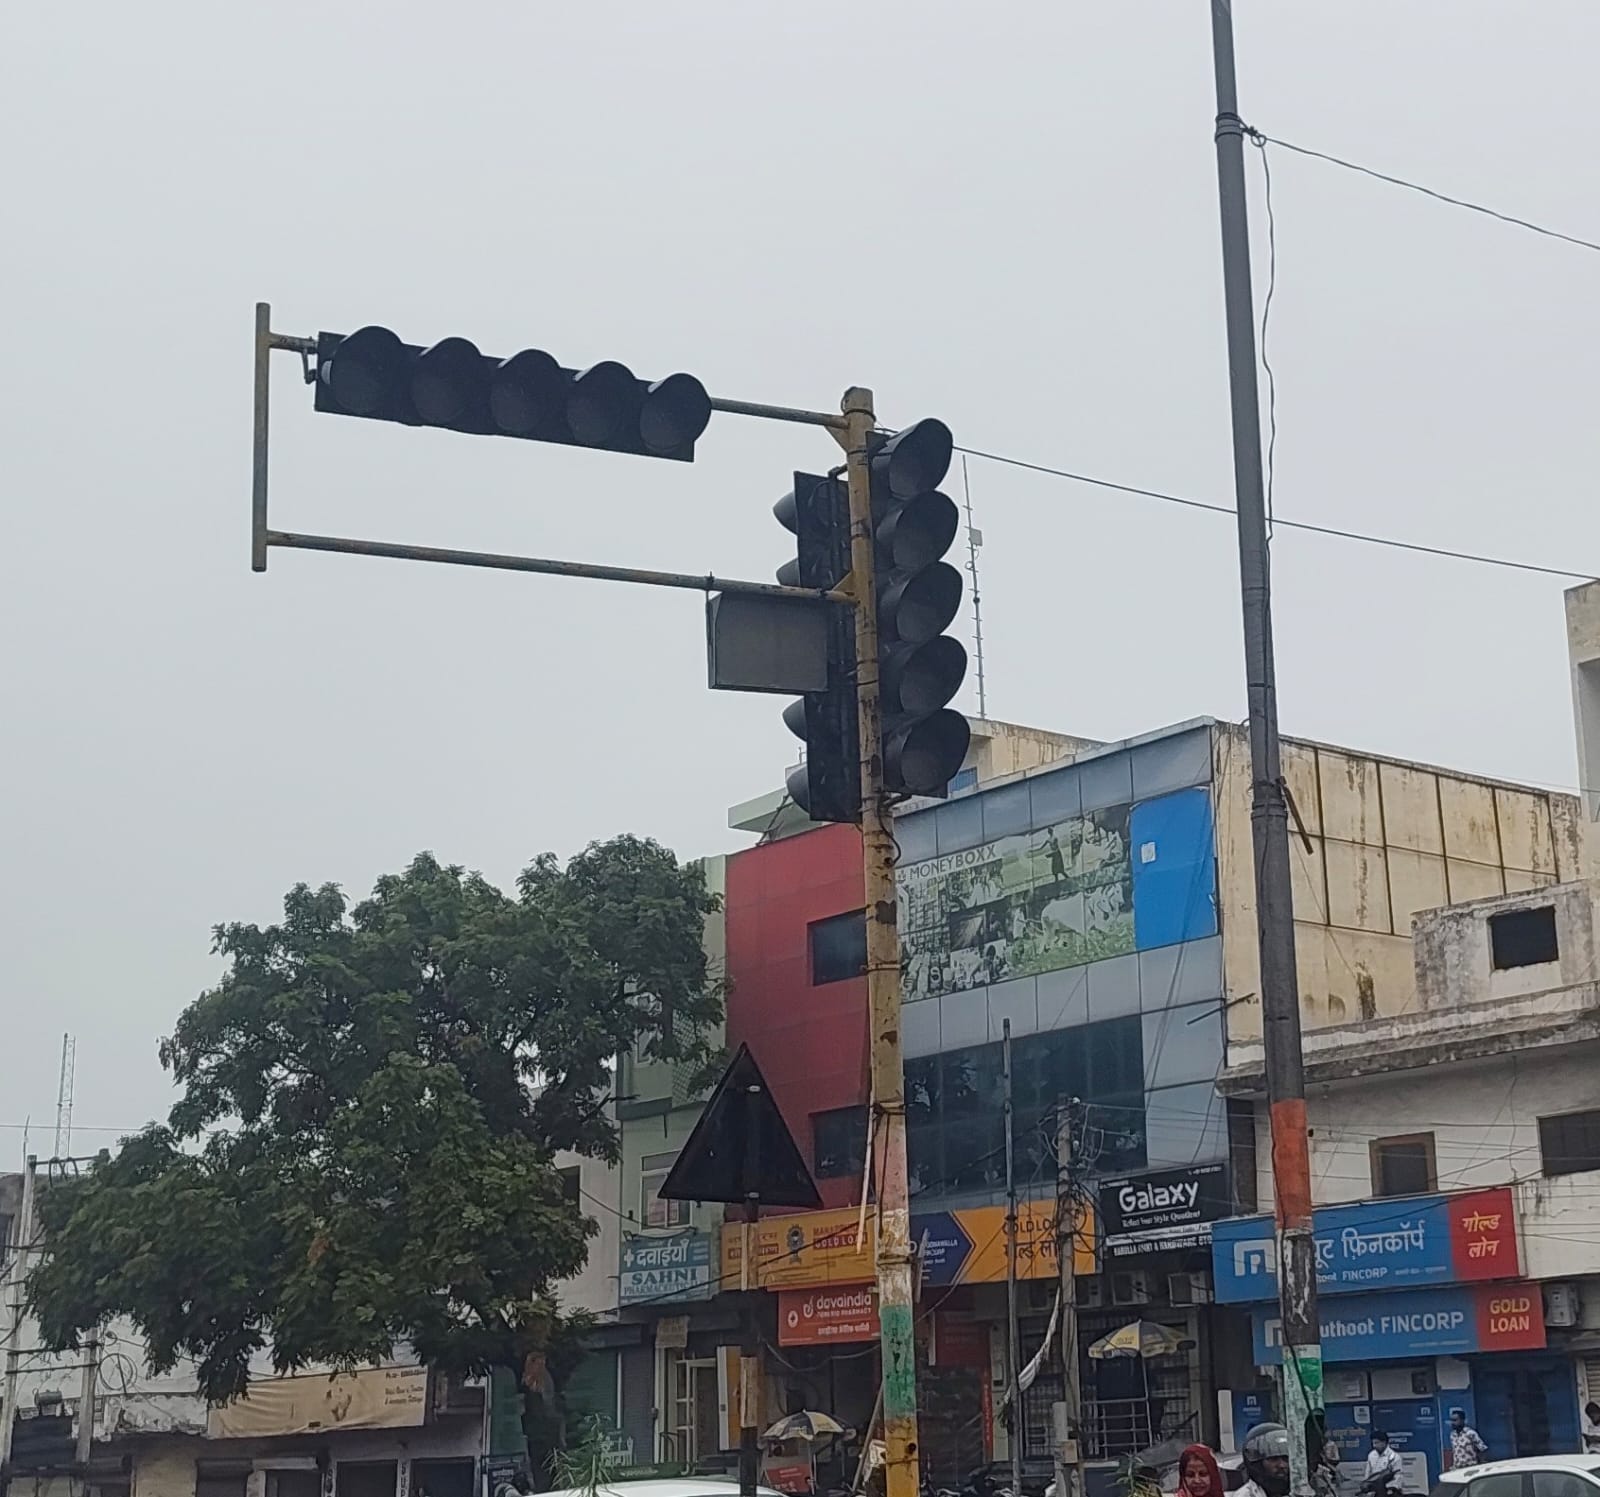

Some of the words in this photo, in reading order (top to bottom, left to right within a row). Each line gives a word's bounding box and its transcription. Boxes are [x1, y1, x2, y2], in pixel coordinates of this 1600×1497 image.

[909, 844, 996, 880] MONEYBOXX
[1119, 1181, 1199, 1212] Galaxy
[1461, 1210, 1501, 1233] गोल्ड
[1467, 1237, 1501, 1258] लोन
[631, 1268, 697, 1286] SAHNI
[1342, 1267, 1388, 1281] FINCORP
[816, 1290, 872, 1310] davaindia
[1489, 1298, 1530, 1315] GOLD
[1319, 1319, 1374, 1338] uthoot
[1381, 1311, 1464, 1334] FINCORP
[1490, 1315, 1530, 1334] LOAN
